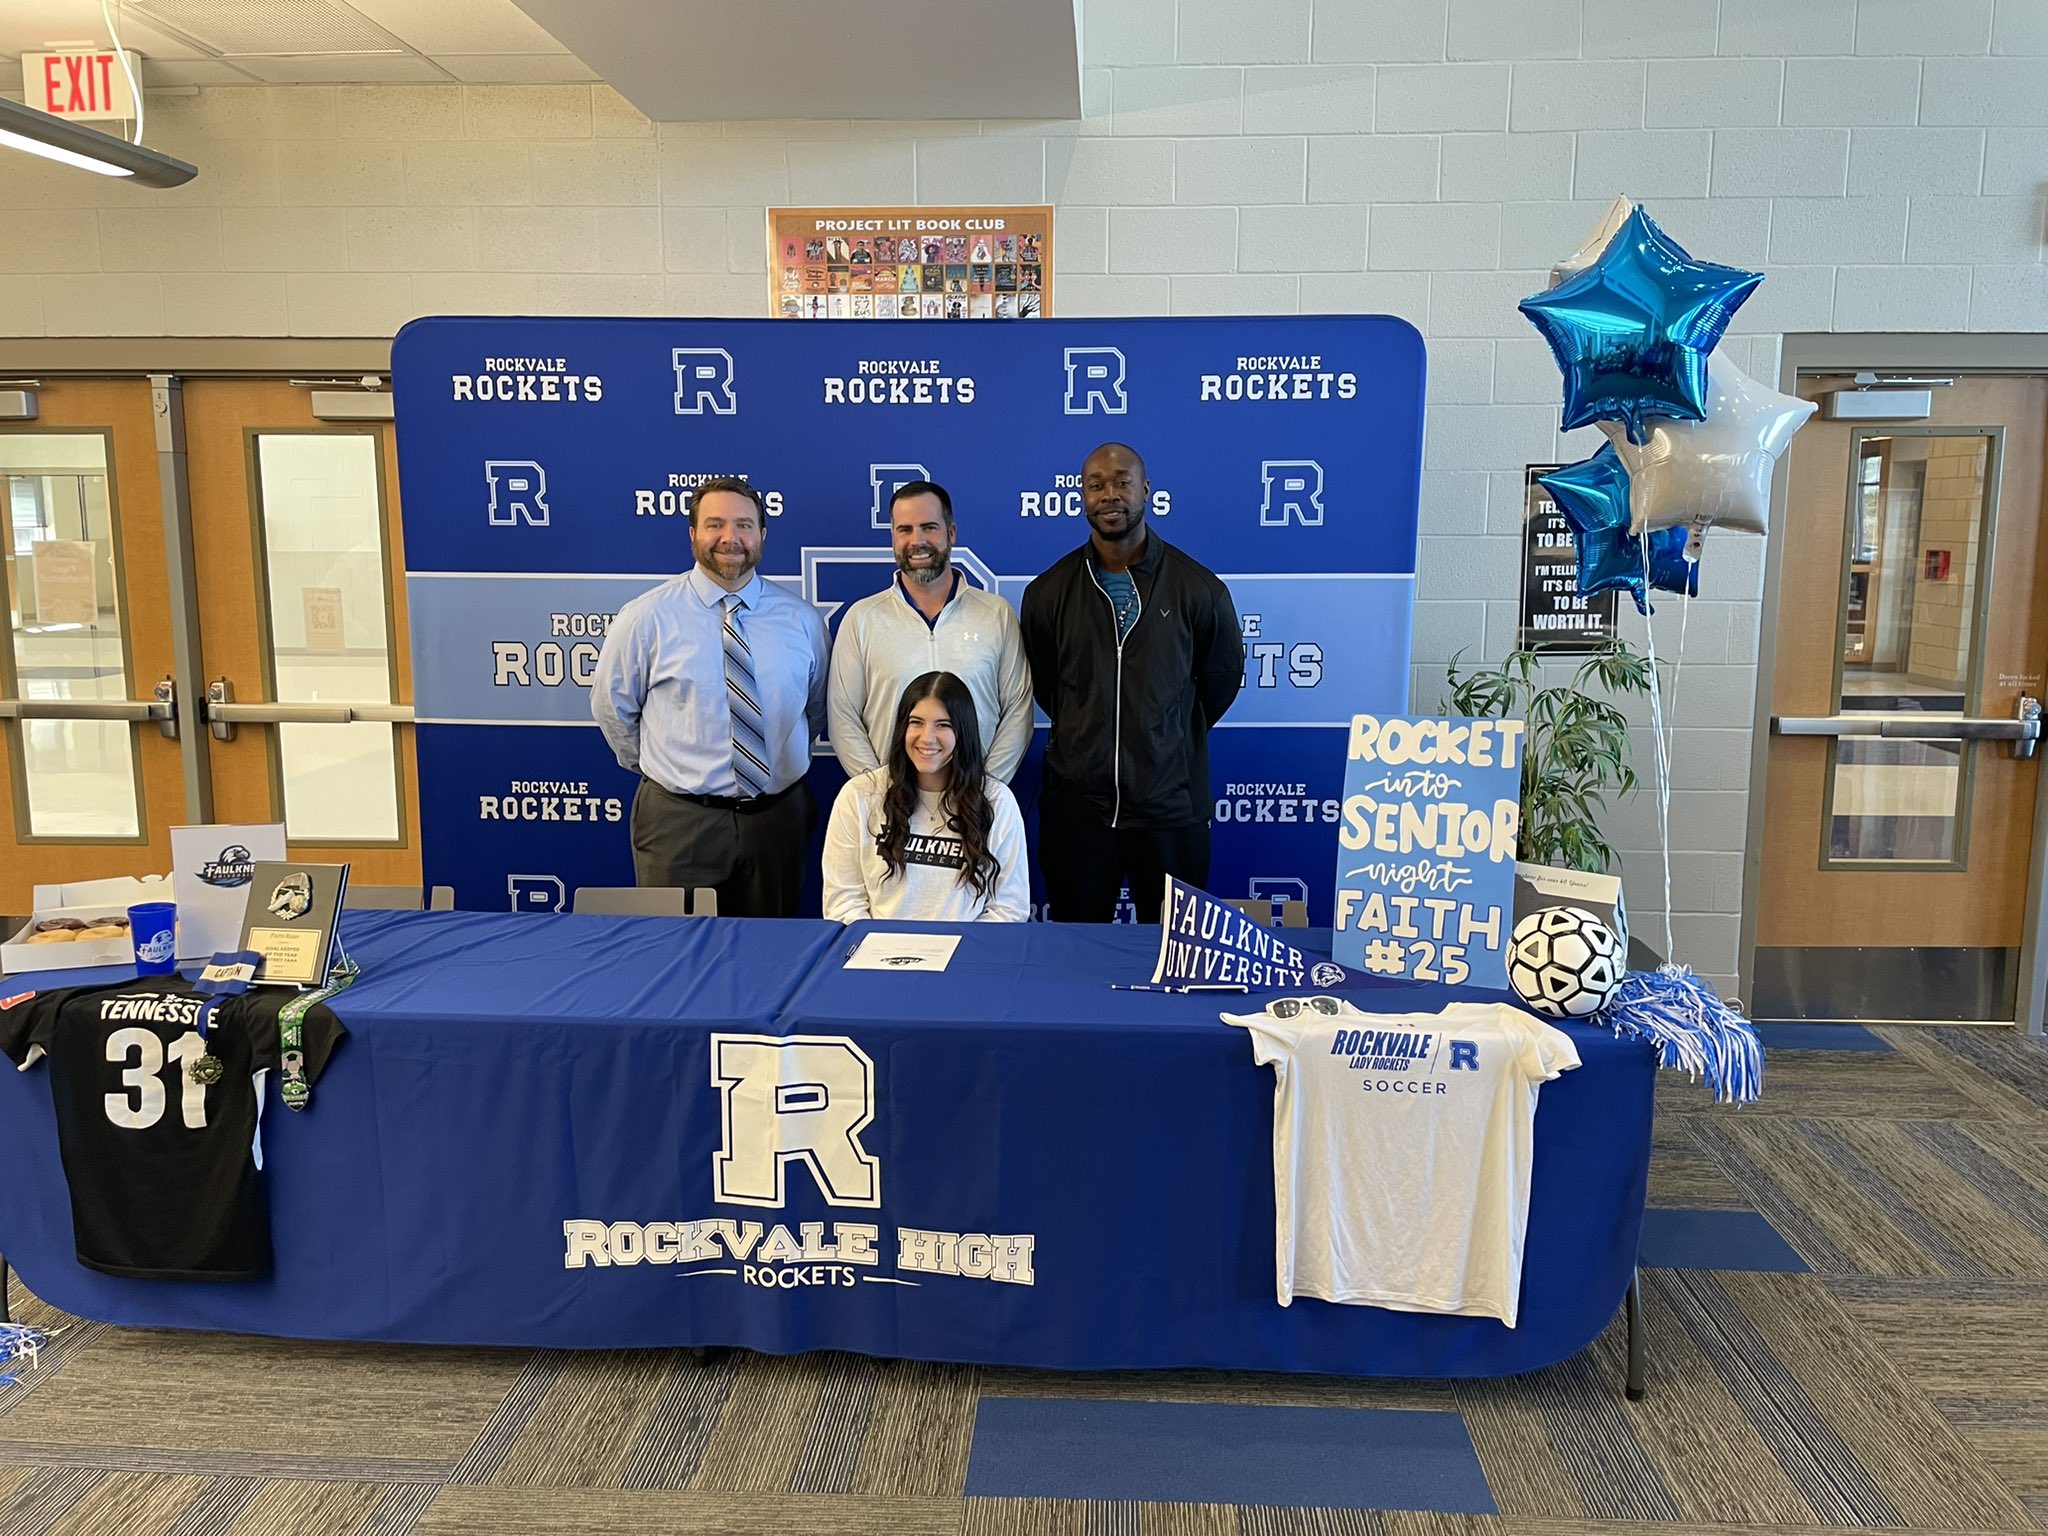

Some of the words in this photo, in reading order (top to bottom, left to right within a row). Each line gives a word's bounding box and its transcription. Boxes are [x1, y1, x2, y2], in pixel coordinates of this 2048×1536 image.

[45, 56, 114, 112] EXIT
[815, 220, 884, 231] PROJECT
[888, 220, 912, 231] LIT
[916, 219, 961, 231] BOOK
[965, 219, 1006, 230] CLUB
[854, 300, 870, 309] 57
[486, 358, 566, 372] ROCKVALE
[858, 360, 940, 374] ROCKVALE
[1237, 356, 1321, 371] ROCKVALE
[452, 375, 604, 402] ROCKETS
[672, 348, 737, 415] R
[824, 377, 976, 404] ROCKETS
[1063, 347, 1127, 415] R
[1200, 373, 1358, 400] ROCKETS
[485, 460, 550, 526] R
[635, 490, 784, 516] ROCS
[1020, 491, 1171, 517] ROCS
[1260, 460, 1324, 526] R
[1548, 518, 1566, 529] IT'S
[1537, 533, 1555, 547] TO
[1556, 534, 1573, 547] BE
[1535, 565, 1549, 576] I'M
[1543, 580, 1563, 592] IT'S
[1553, 597, 1570, 610] TO
[1572, 597, 1588, 610] BE
[1533, 615, 1584, 630] WORTH
[1587, 614, 1604, 630] IT.
[1349, 714, 1525, 768] ROCKET
[511, 781, 588, 794] ROCKVALE
[1226, 783, 1306, 796] ROCKVALE
[1365, 770, 1462, 798] into
[480, 796, 622, 822] ROCKETS
[1215, 799, 1340, 823] OCKETS
[1339, 794, 1520, 862] SENIOR
[205, 863, 255, 878] FAULKNE
[904, 852, 958, 865] OCCER
[1345, 858, 1473, 894] night
[1172, 887, 1304, 969] FAULKNER
[1335, 889, 1501, 950] FAITH
[1166, 938, 1305, 987] UNIVERSITY
[1364, 938, 1470, 985] #25
[1330, 1029, 1433, 1060] ROCKVALE
[1448, 1039, 1480, 1072] R
[1349, 1056, 1372, 1070] LADY
[1373, 1057, 1410, 1072] ROCKETS
[104, 1027, 208, 1129] 31
[1363, 1079, 1447, 1095] SOCCER
[711, 1032, 881, 1208] R
[563, 1218, 878, 1268] ROCKVALE
[897, 1227, 1035, 1286] HIGH
[743, 1264, 856, 1288] ROCKETS
